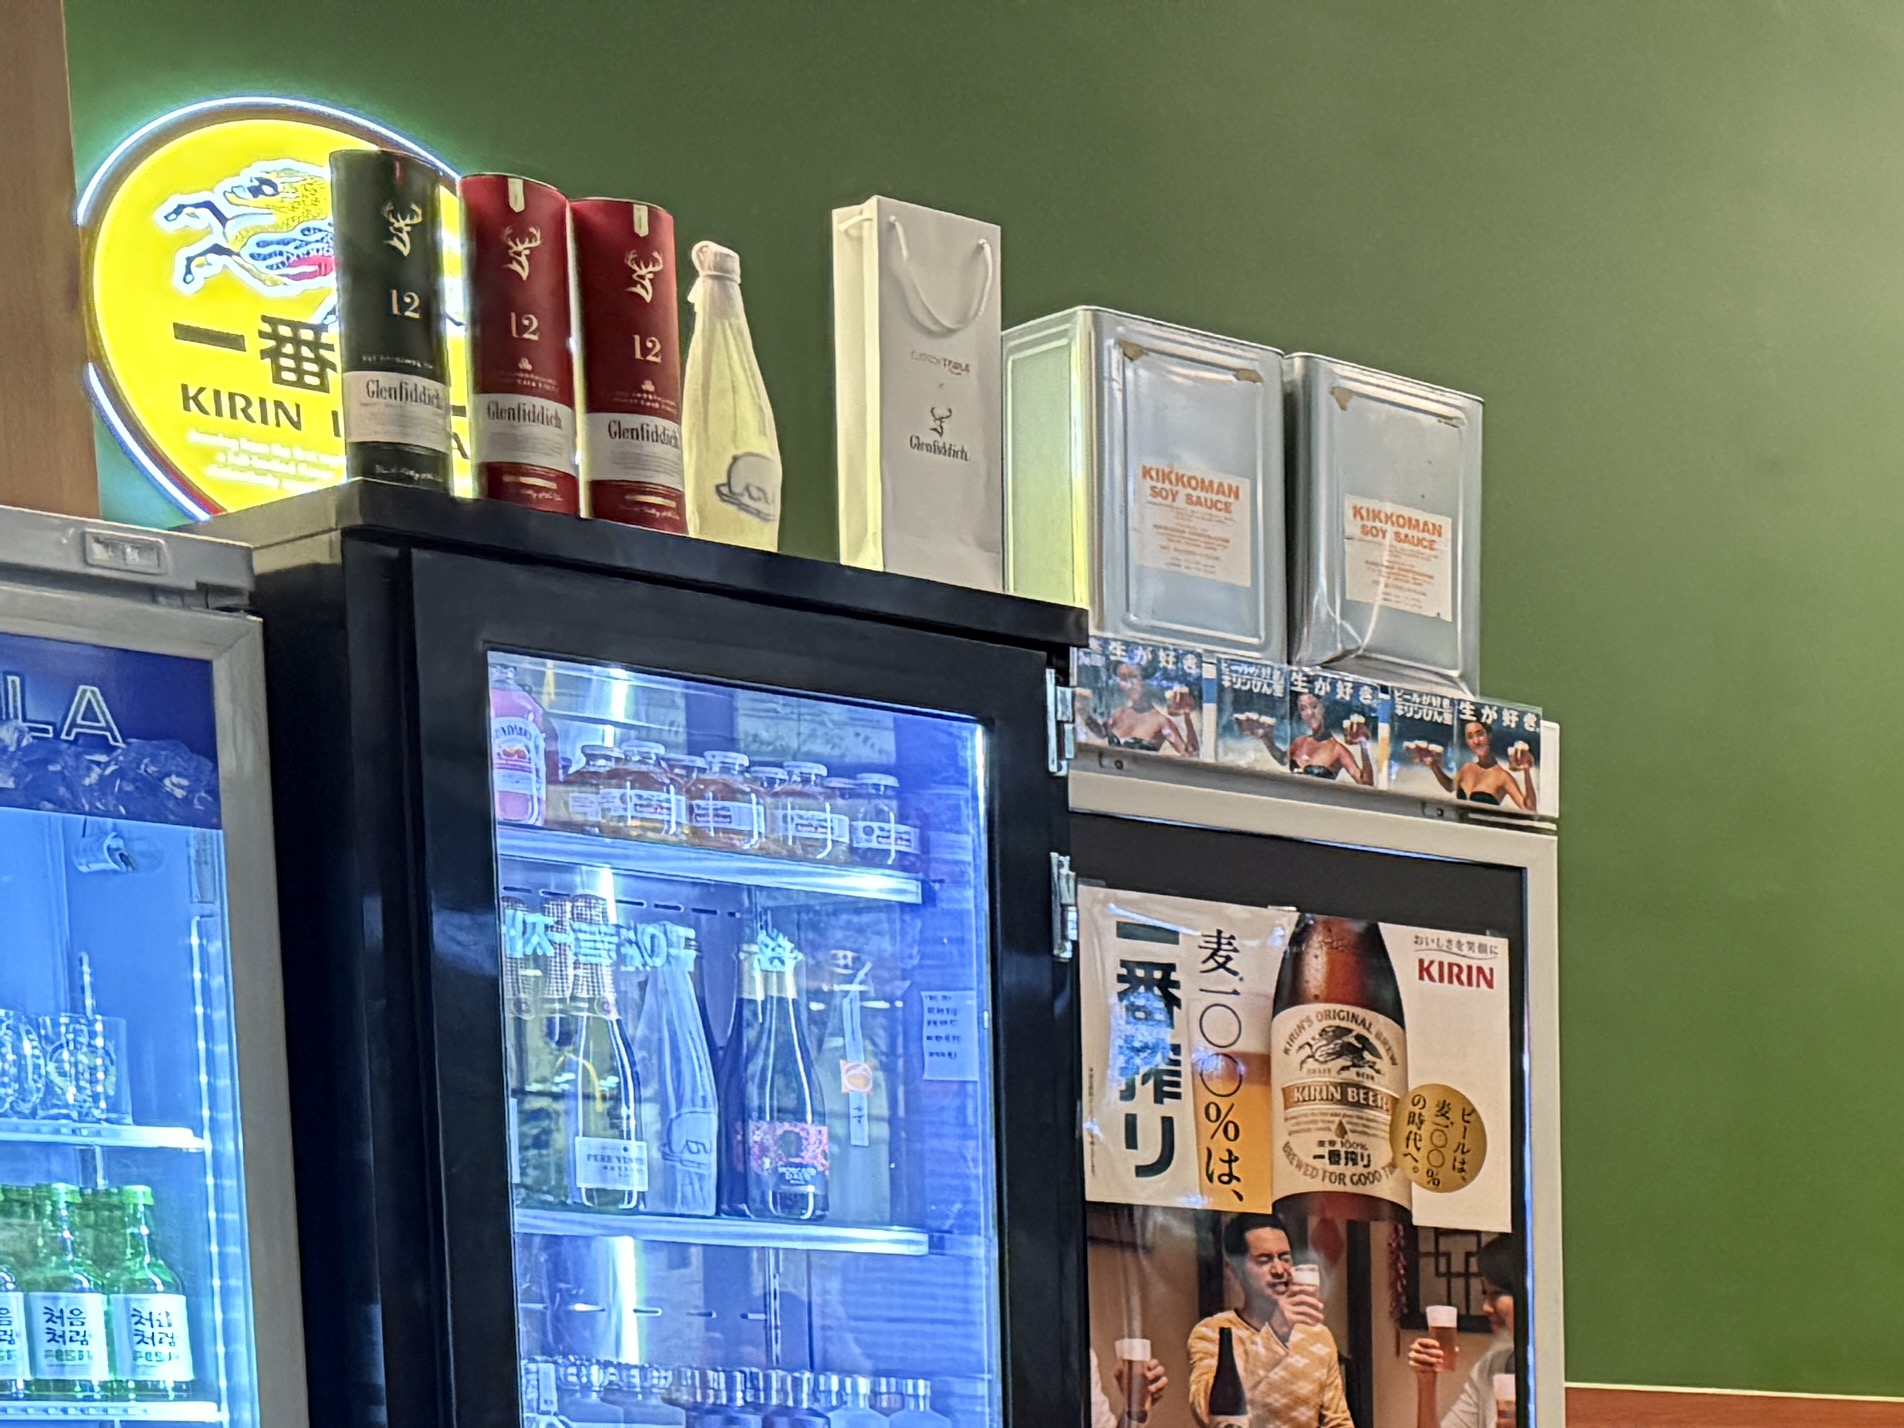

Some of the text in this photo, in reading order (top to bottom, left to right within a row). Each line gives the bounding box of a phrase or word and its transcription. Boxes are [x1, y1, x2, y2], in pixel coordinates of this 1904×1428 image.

[391, 289, 421, 319] 12
[511, 312, 539, 341] 12
[633, 334, 662, 363] 12
[180, 383, 302, 431] KIRIN
[366, 378, 443, 409] Glenfiddich
[487, 400, 563, 429] Glenfiddich
[608, 420, 681, 447] Glenfiddich
[910, 434, 969, 462] Glenfiddich
[1142, 465, 1240, 501] KIKKOMAN
[1150, 485, 1233, 514] SOY SAUCE
[1352, 505, 1443, 538] KIKKOMAN
[1360, 524, 1438, 551] SOY SAUCE
[0, 671, 127, 748] LA
[1418, 958, 1494, 990] KIRIN
[1315, 1009, 1374, 1034] ORIGINAL
[1293, 1085, 1390, 1112] KIRIN BEER
[1322, 1167, 1347, 1187] FOR
[1350, 1169, 1382, 1186] GOOD
[43, 1306, 86, 1327] 처음
[45, 1327, 89, 1346] 처럼
